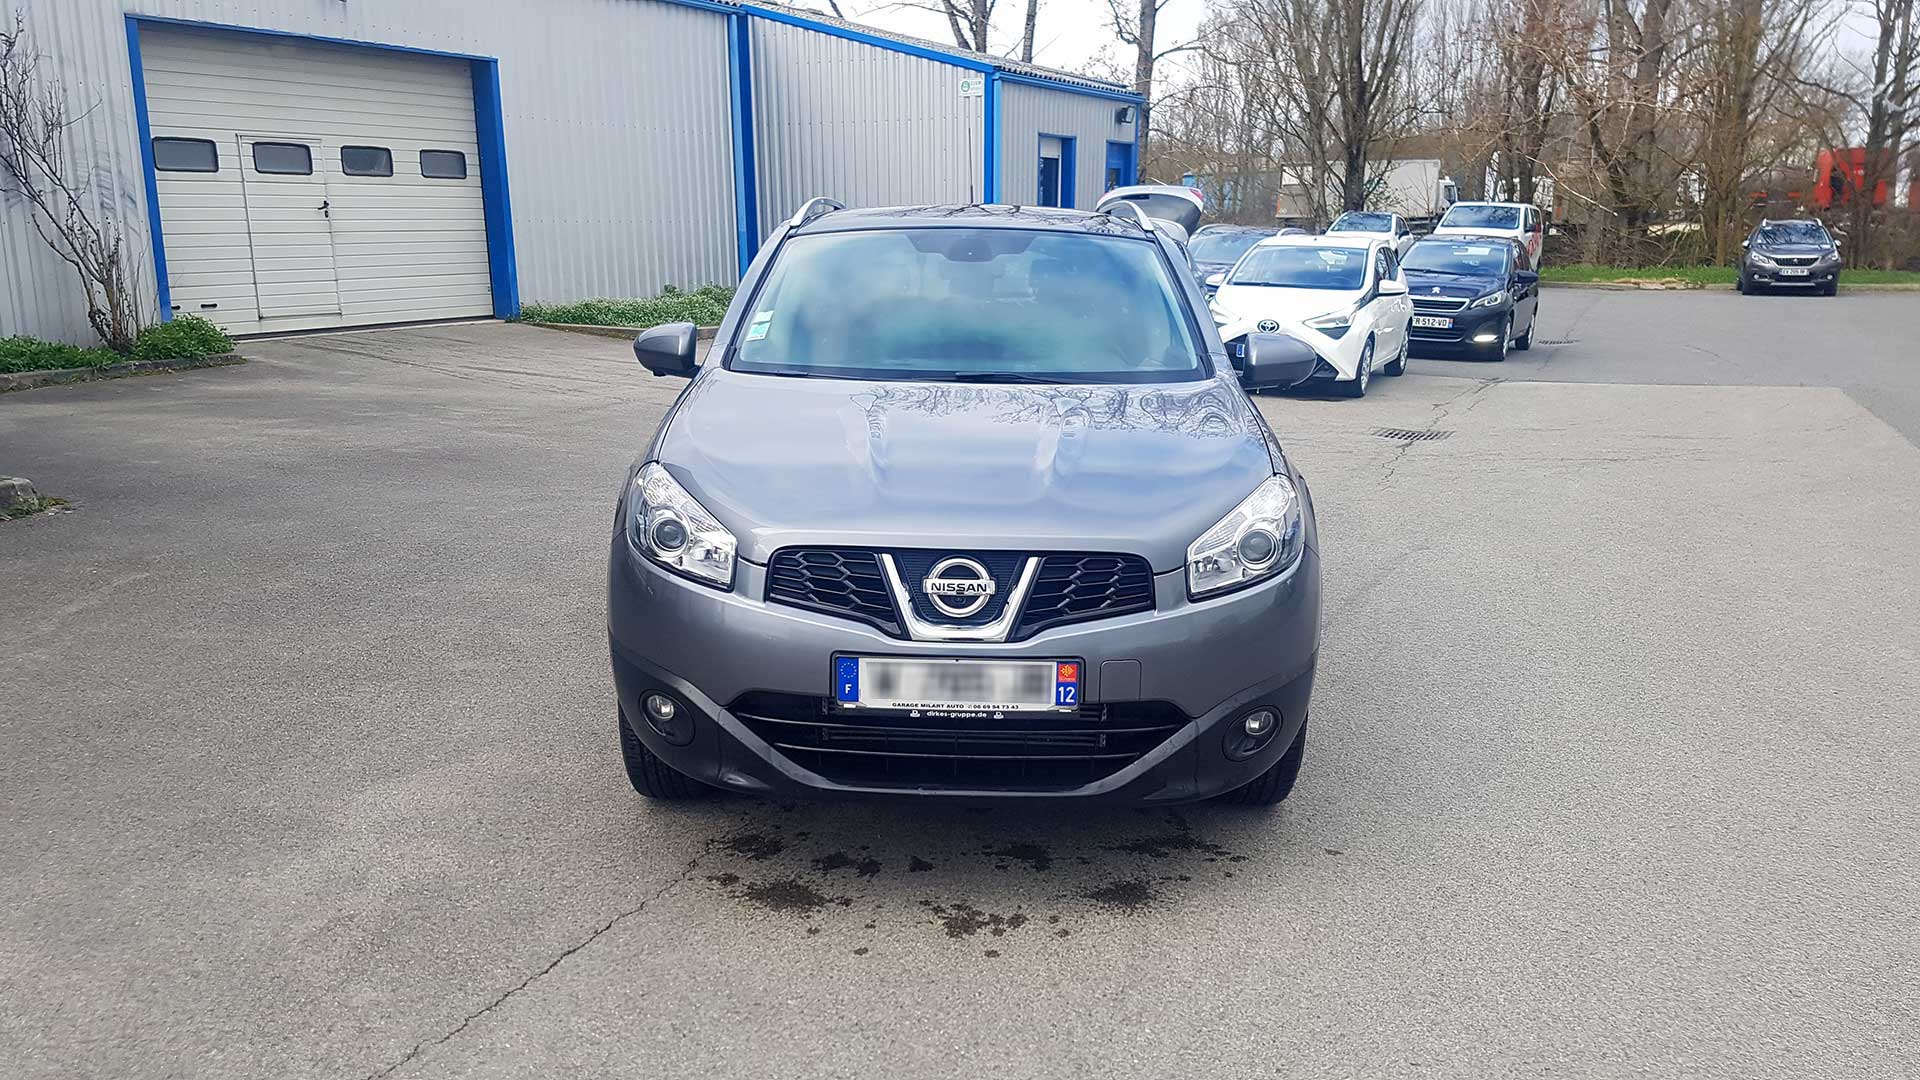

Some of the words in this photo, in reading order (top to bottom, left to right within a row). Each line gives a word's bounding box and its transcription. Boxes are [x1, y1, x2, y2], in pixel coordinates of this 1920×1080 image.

[931, 583, 987, 592] NISSAN
[845, 684, 852, 694] F
[1058, 686, 1075, 703] 12
[926, 710, 987, 718] dirkes-gruppe.de
